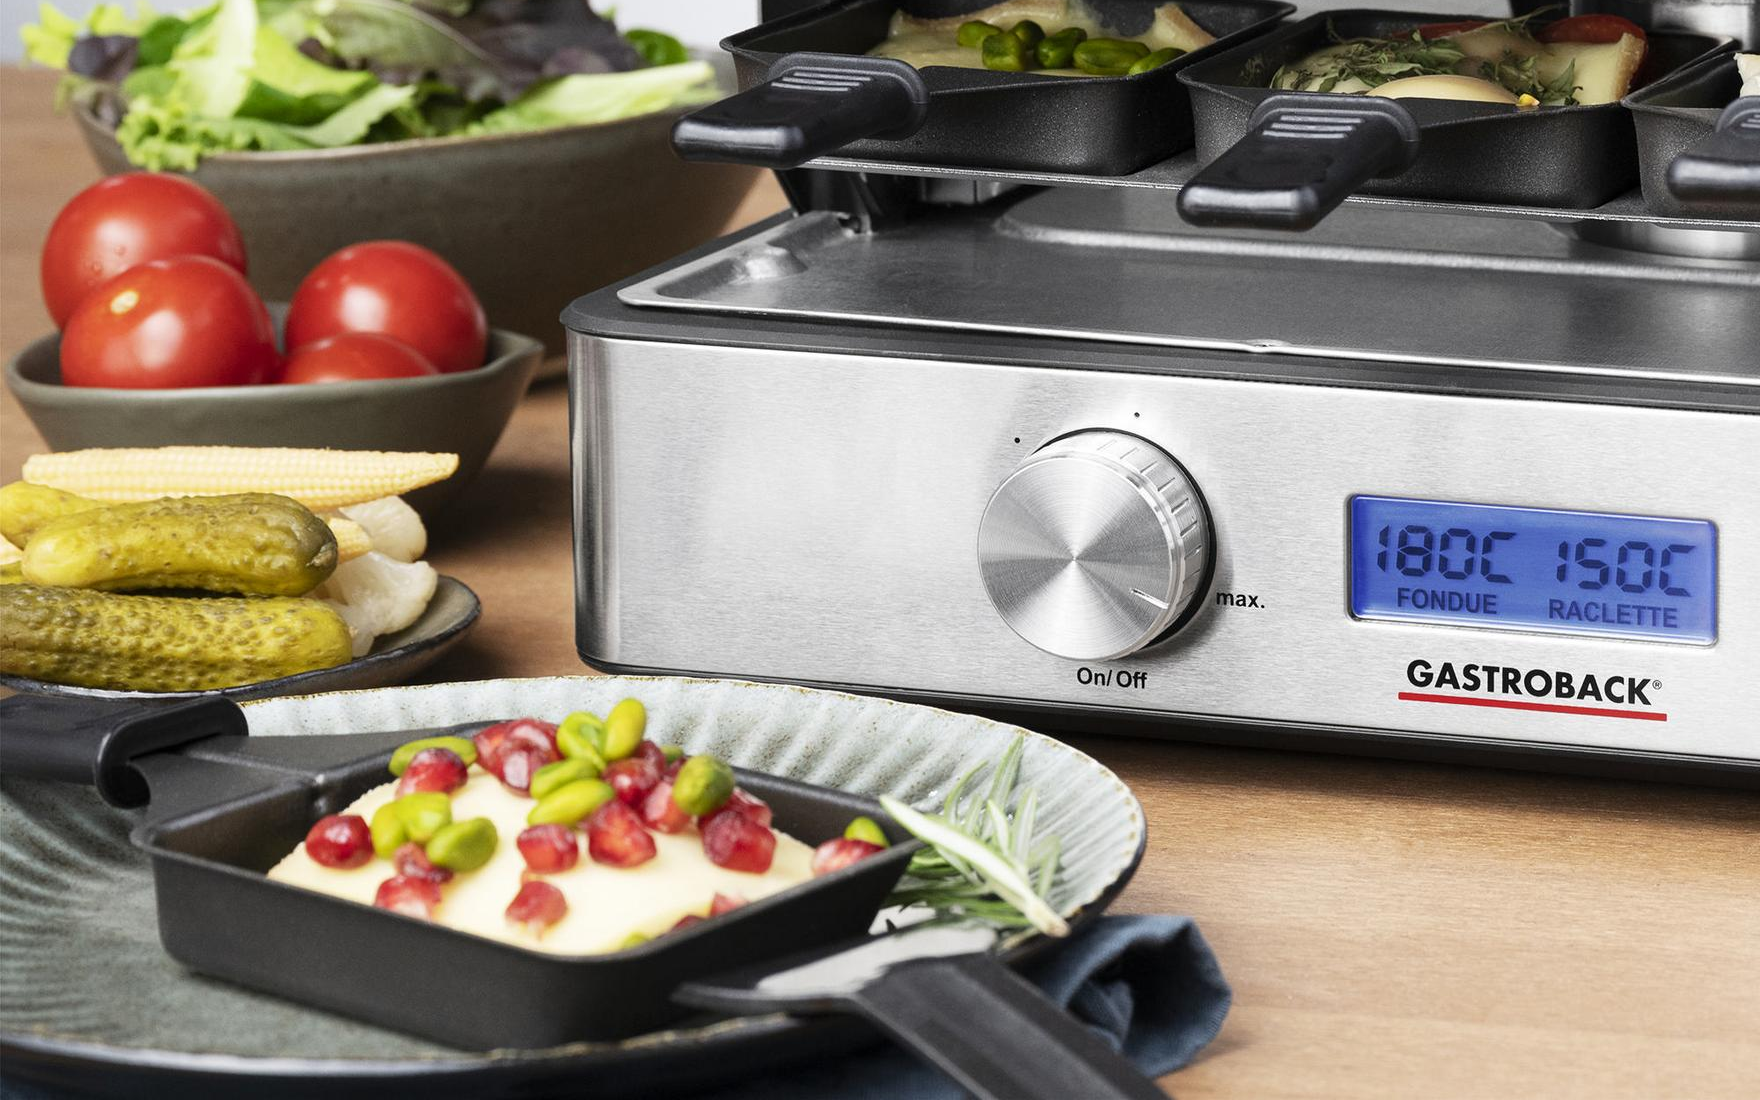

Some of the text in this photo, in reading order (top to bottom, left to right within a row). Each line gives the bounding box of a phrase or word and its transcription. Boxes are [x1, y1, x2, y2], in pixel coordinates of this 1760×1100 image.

[1216, 592, 1265, 608] max.
[1397, 587, 1498, 615] FONDUE
[1548, 598, 1678, 629] RACLETTE
